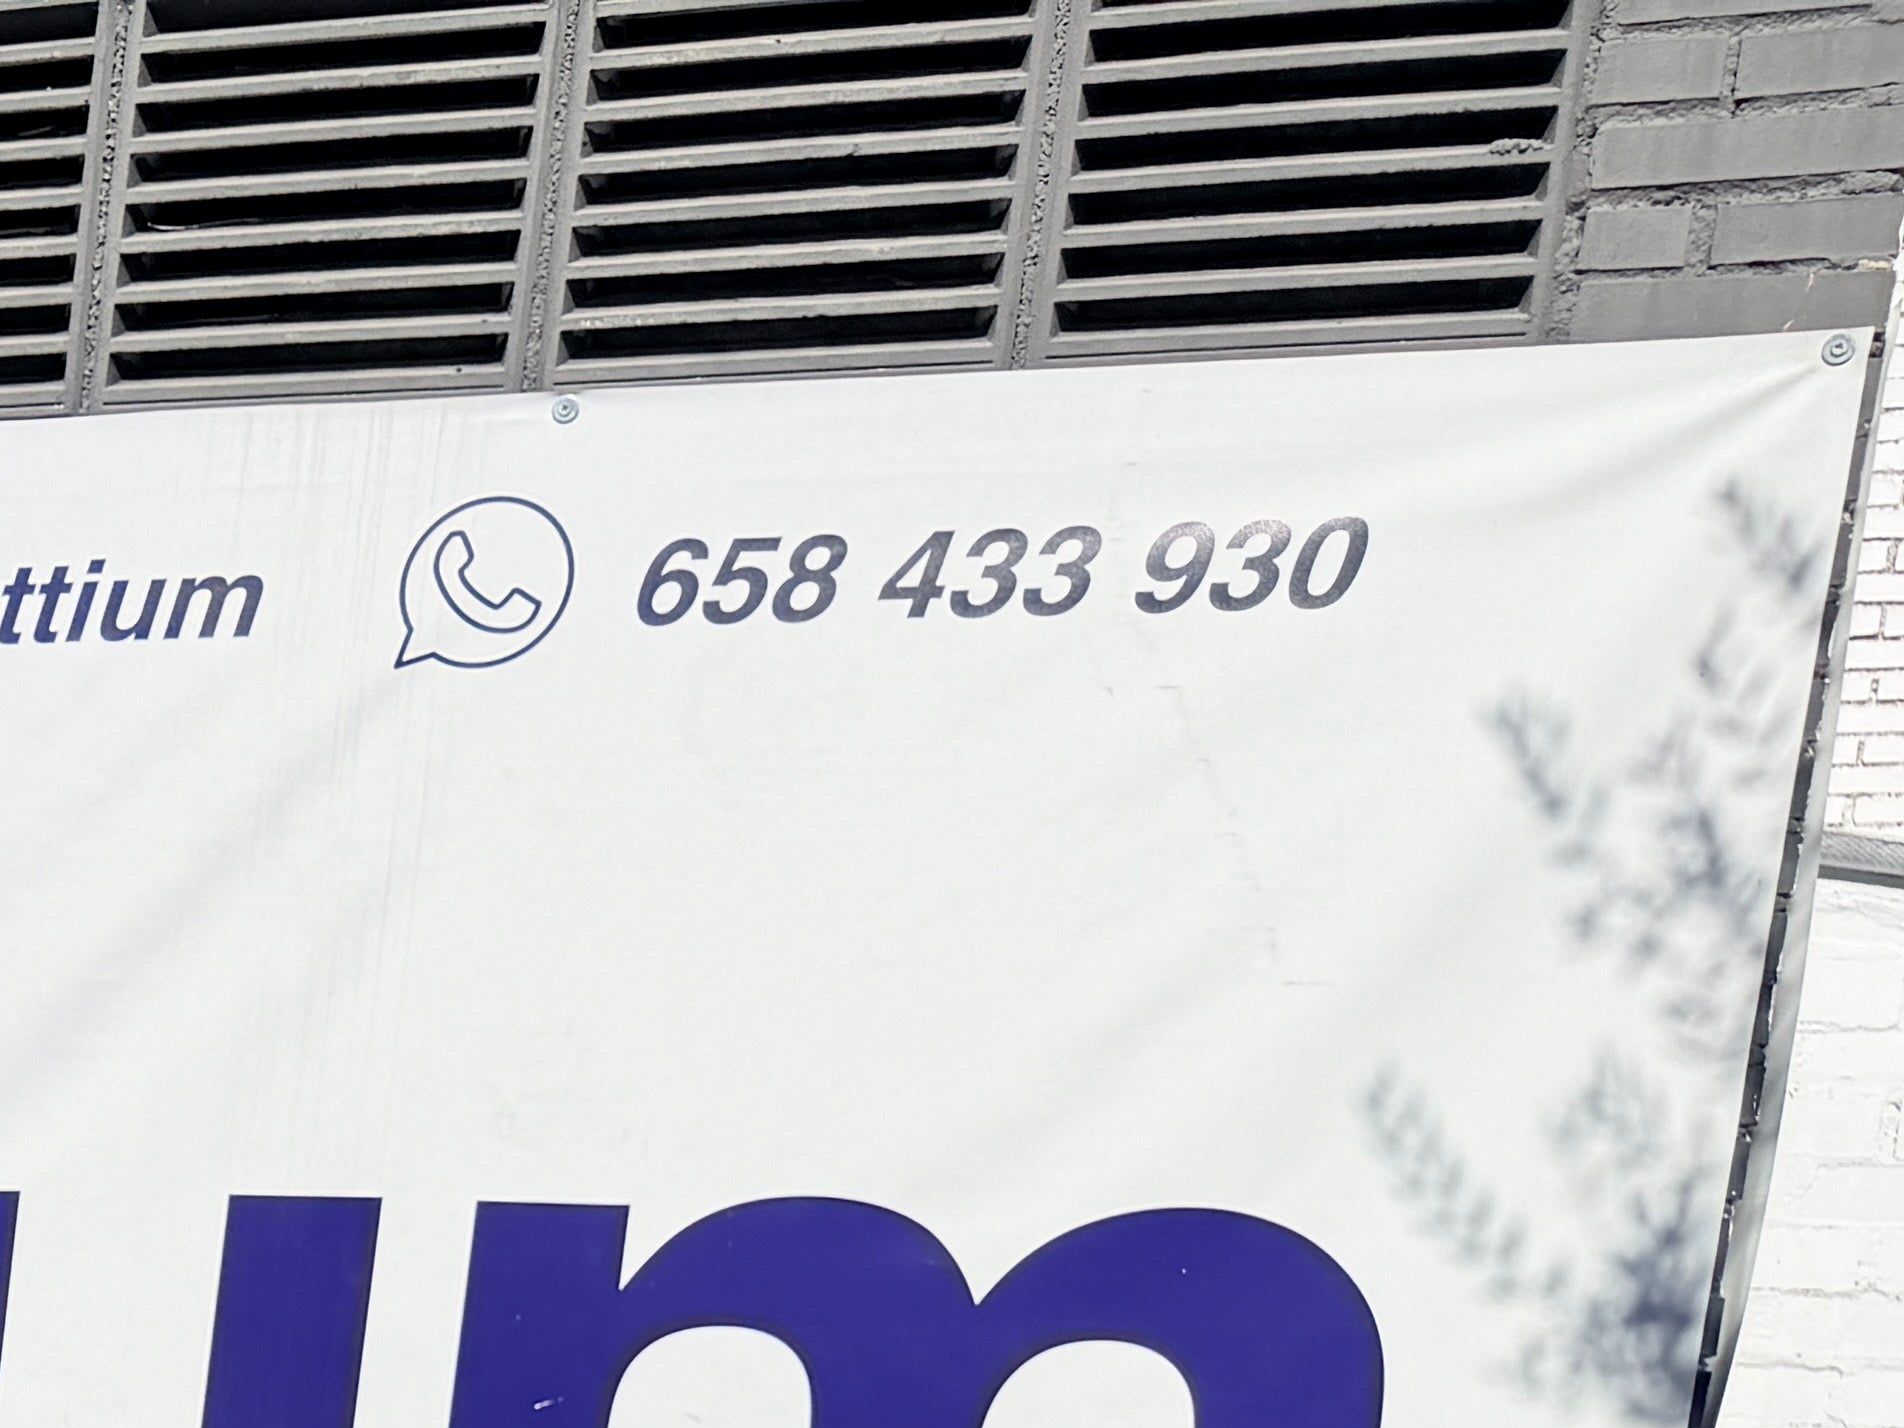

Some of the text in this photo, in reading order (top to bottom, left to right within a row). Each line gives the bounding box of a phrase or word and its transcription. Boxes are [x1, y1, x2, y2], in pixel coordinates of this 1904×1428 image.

[636, 515, 1370, 627] 658 433 930
